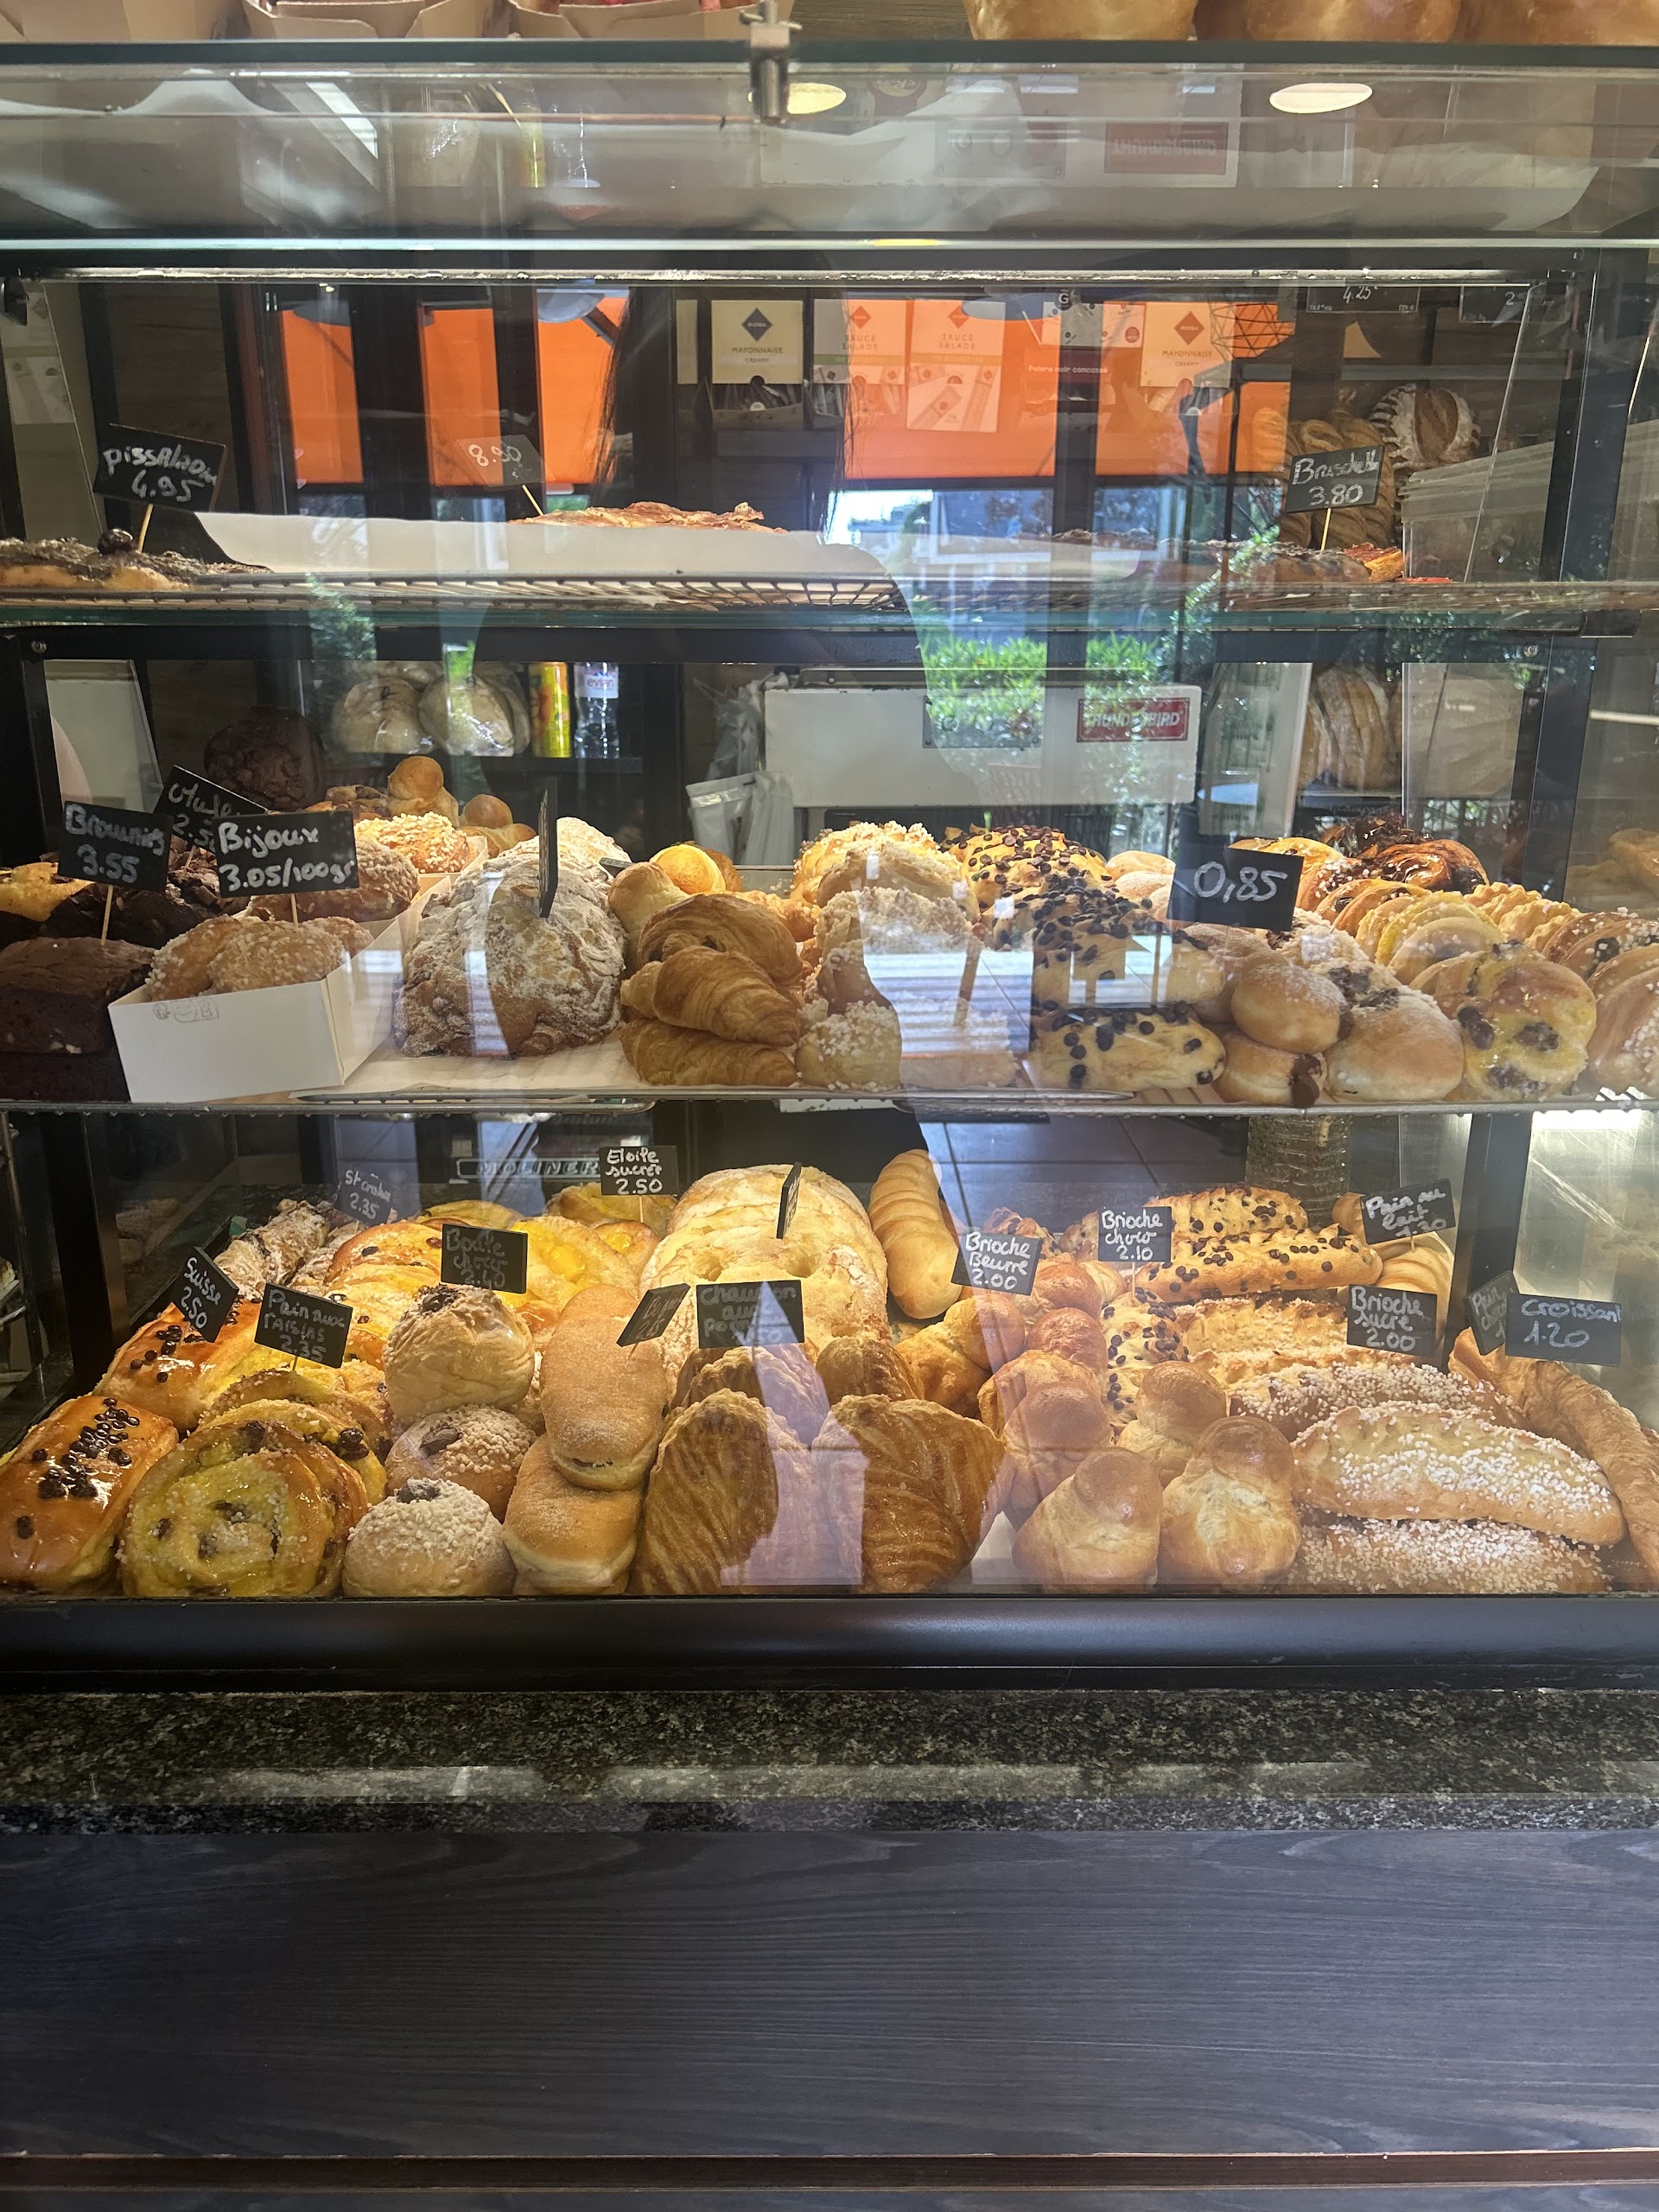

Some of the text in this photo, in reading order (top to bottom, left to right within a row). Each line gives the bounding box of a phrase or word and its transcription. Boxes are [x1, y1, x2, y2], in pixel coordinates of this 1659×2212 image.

[942, 333, 974, 341] SAUCE
[132, 469, 206, 503] 4.95
[1308, 484, 1363, 507] 3.80
[1084, 711, 1181, 728] THUNDBIRD
[218, 822, 319, 858] Bijoux
[77, 844, 140, 883] 3.55
[1194, 861, 1288, 904] 0,85
[615, 1178, 663, 1195] 2.50
[350, 1192, 380, 1220] 2.35
[1102, 1209, 1163, 1229] Brioche
[965, 1231, 1031, 1259] Brioche
[1116, 1244, 1154, 1261] 2.10
[969, 1251, 1028, 1275] Beurre
[972, 1268, 1018, 1290] 2.00
[181, 1286, 207, 1329] 2.50
[268, 1288, 309, 1319] Pain
[1351, 1286, 1424, 1316] Brioche
[1521, 1299, 1622, 1323] Croissant
[1366, 1327, 1416, 1351] 2.00
[1523, 1320, 1591, 1348] 1.20
[280, 1334, 327, 1363] 2.35
